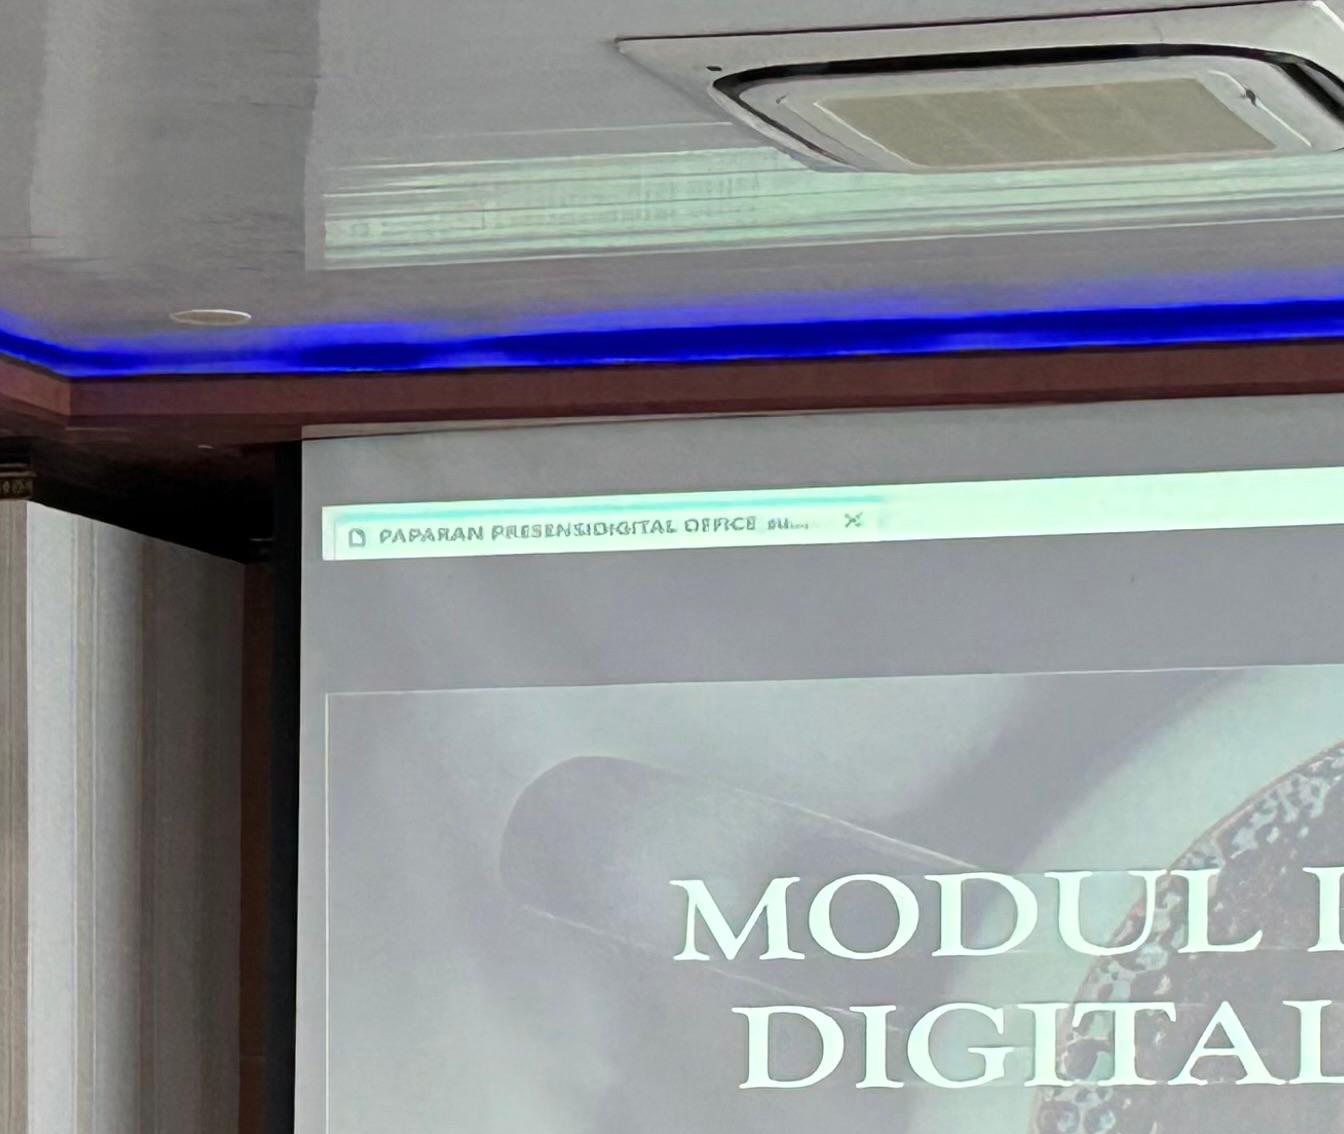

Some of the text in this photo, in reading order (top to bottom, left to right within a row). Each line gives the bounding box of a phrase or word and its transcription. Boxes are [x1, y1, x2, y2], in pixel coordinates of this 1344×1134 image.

[379, 525, 484, 544] PAPARAN
[684, 515, 757, 533] OFFICE
[668, 867, 1264, 962] MODUL
